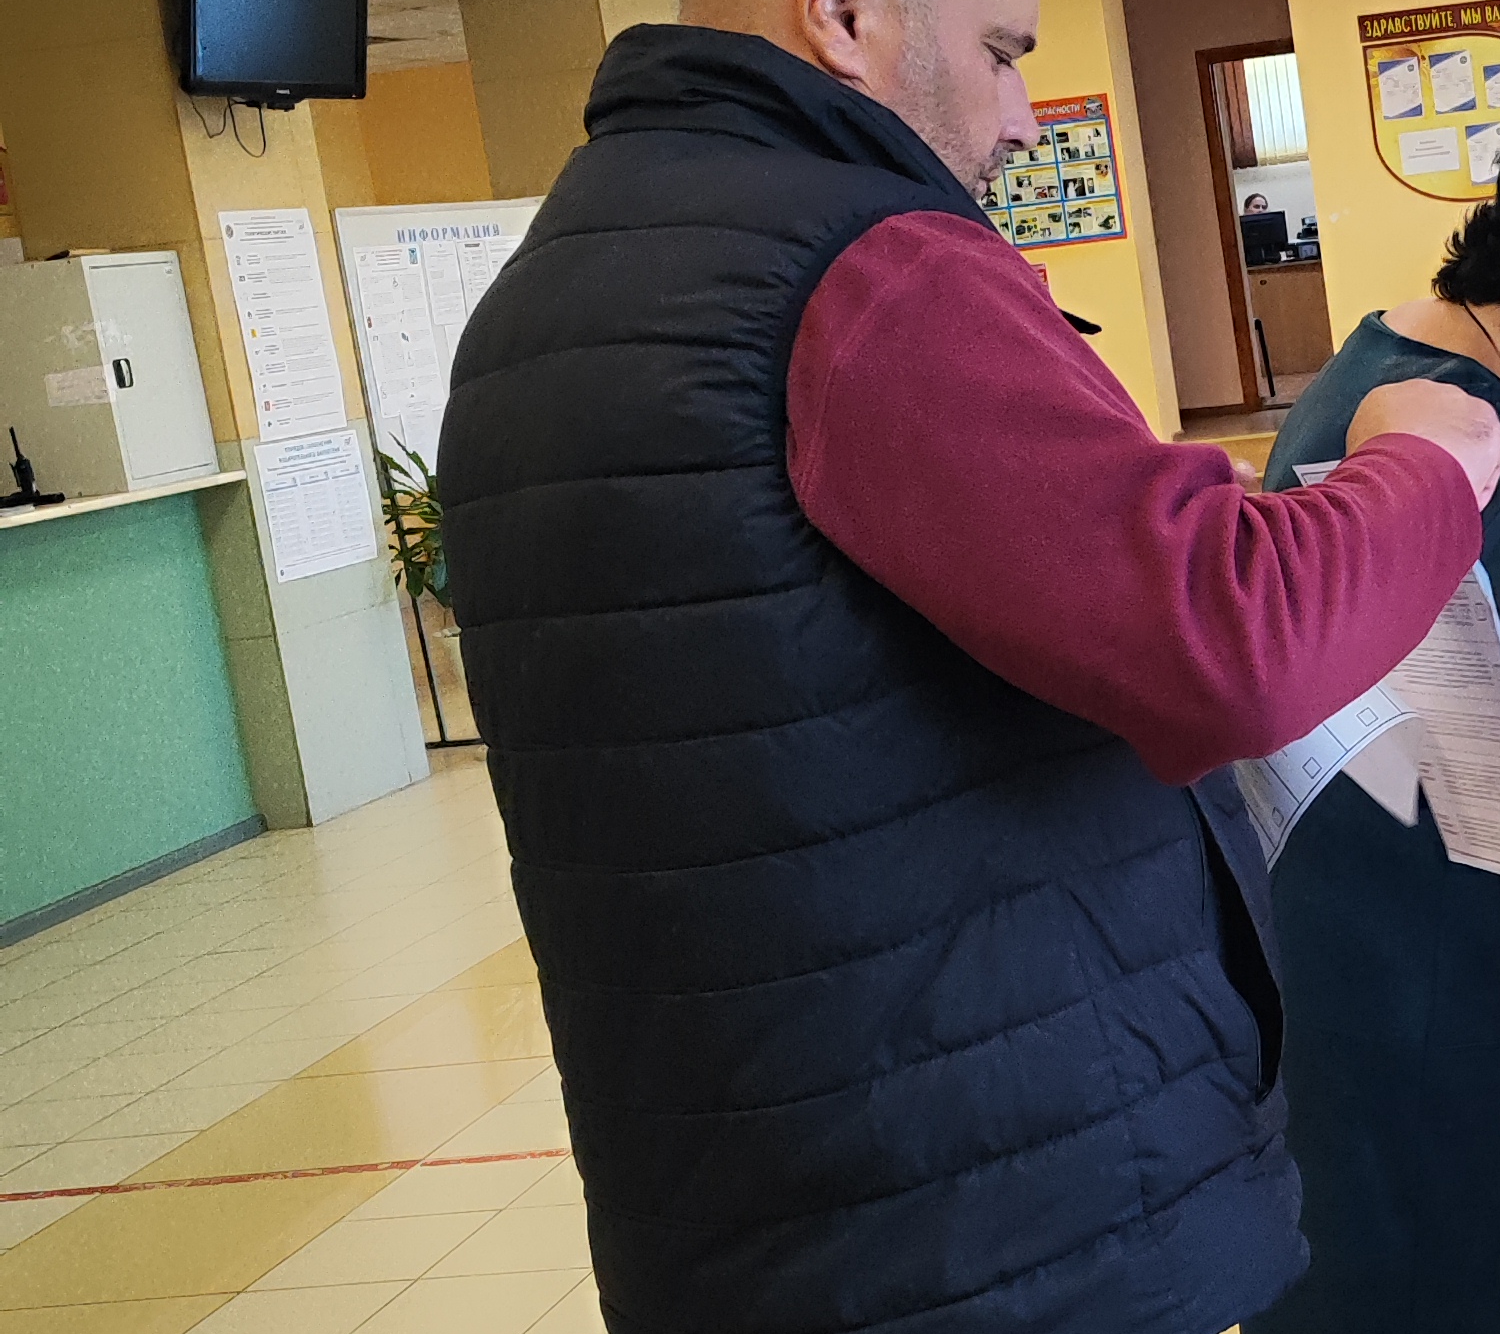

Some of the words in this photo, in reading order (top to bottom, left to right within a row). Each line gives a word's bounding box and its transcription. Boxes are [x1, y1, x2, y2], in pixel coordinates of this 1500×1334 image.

[1364, 9, 1457, 38] ЗДРАВСТВУЙТЕ,
[1460, 7, 1482, 26] МЫ
[396, 223, 500, 243] ИНФОРМАЦИЯ
